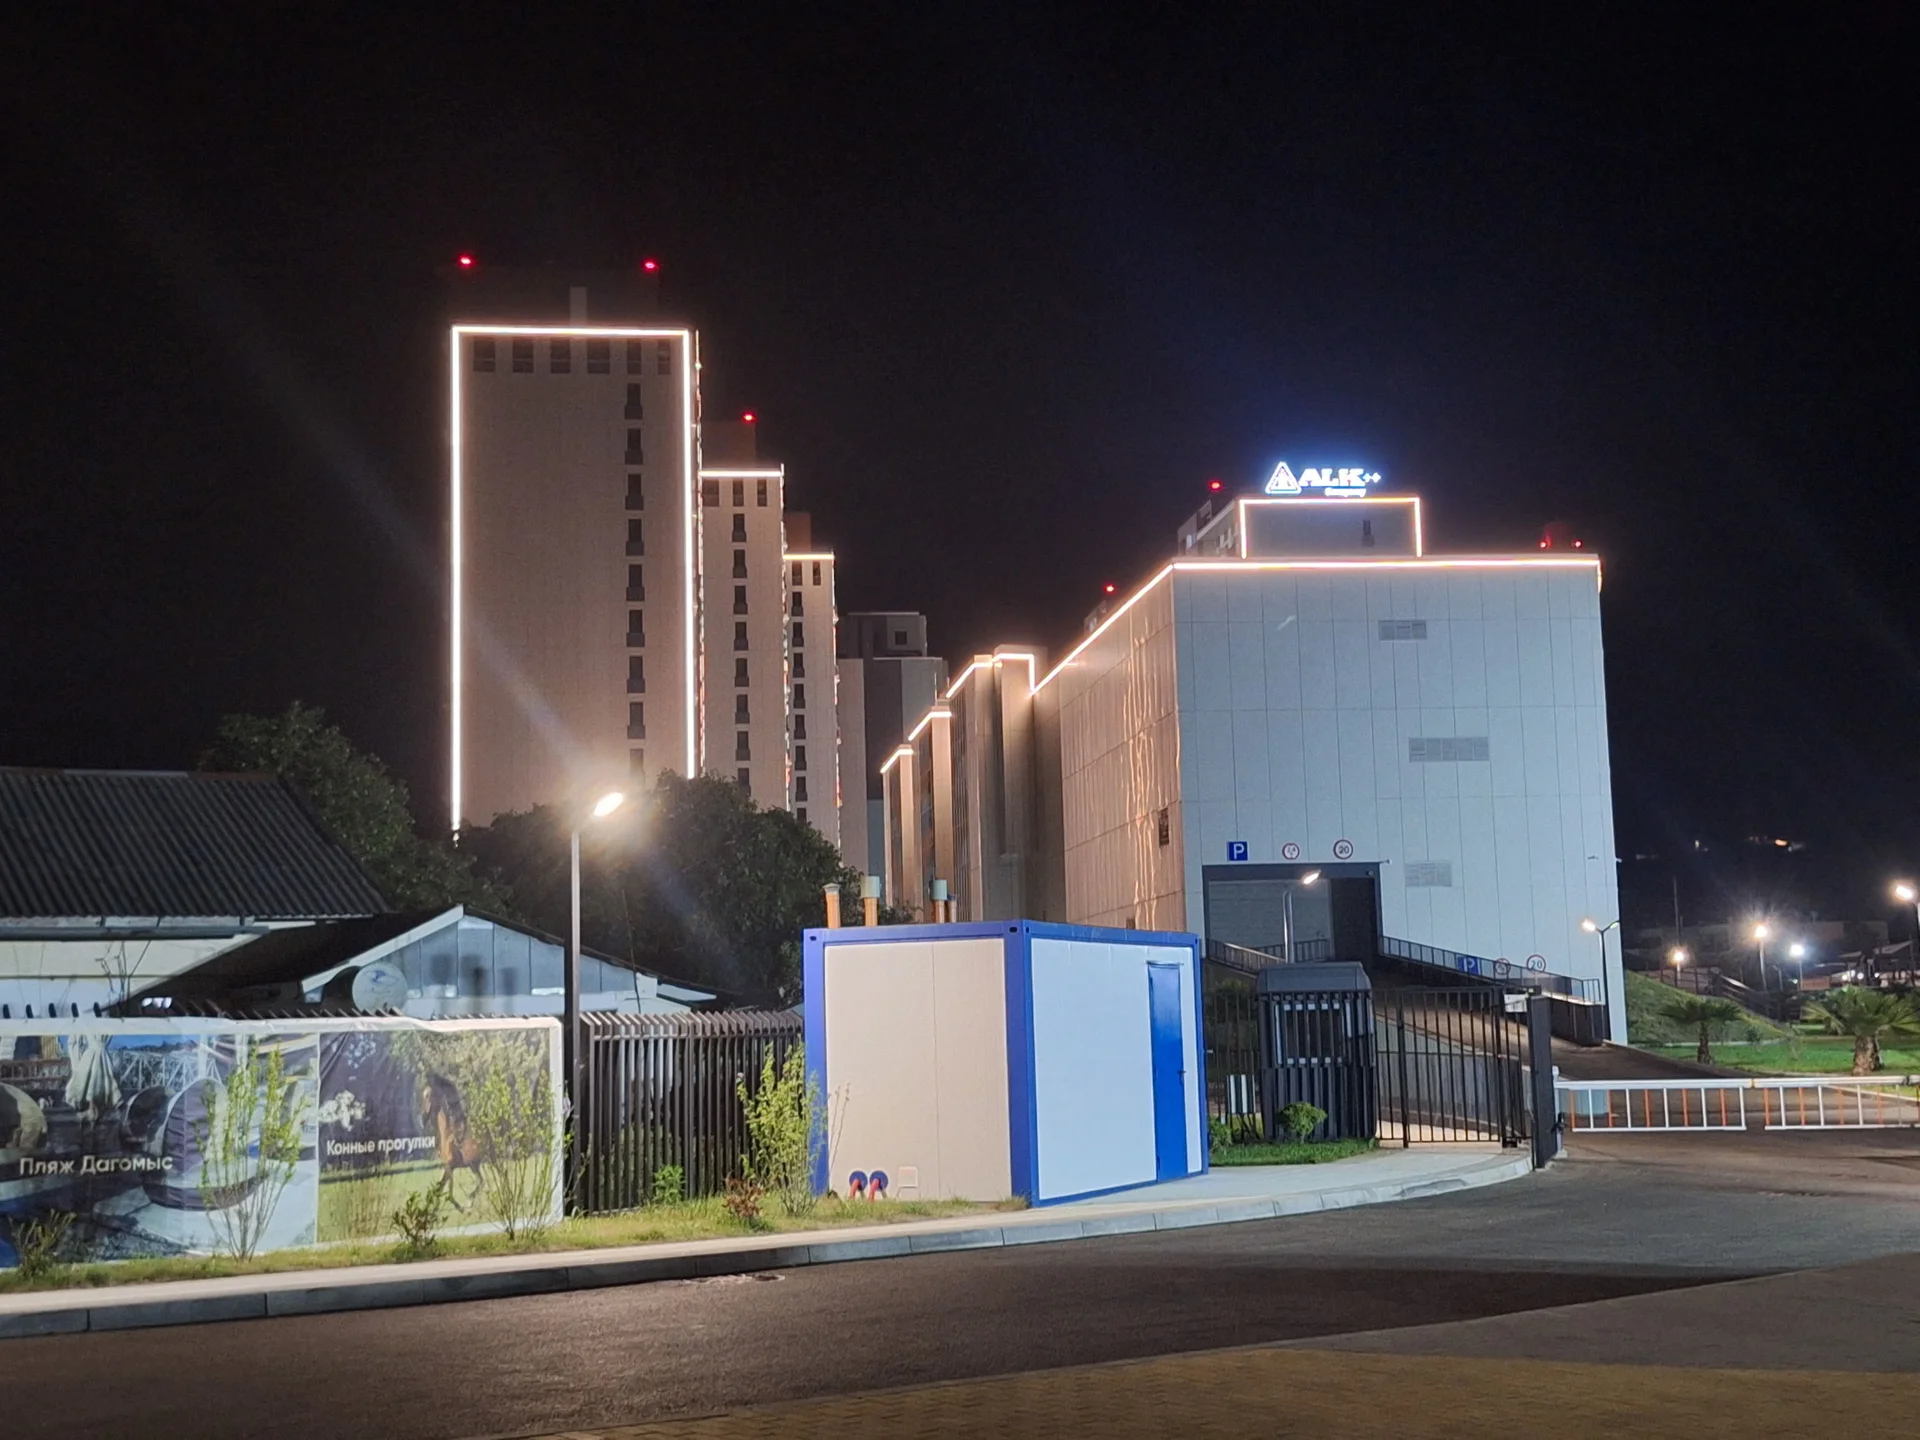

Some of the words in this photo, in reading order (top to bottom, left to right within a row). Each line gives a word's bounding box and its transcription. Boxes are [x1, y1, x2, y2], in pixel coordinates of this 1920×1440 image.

[1233, 843, 1245, 859] P
[1339, 845, 1350, 854] 20
[1531, 959, 1543, 970] 20
[326, 1139, 376, 1156] Конные
[378, 1136, 436, 1156] прогулки
[19, 1157, 75, 1176] Пляж
[80, 1155, 173, 1176] Дагомыс
